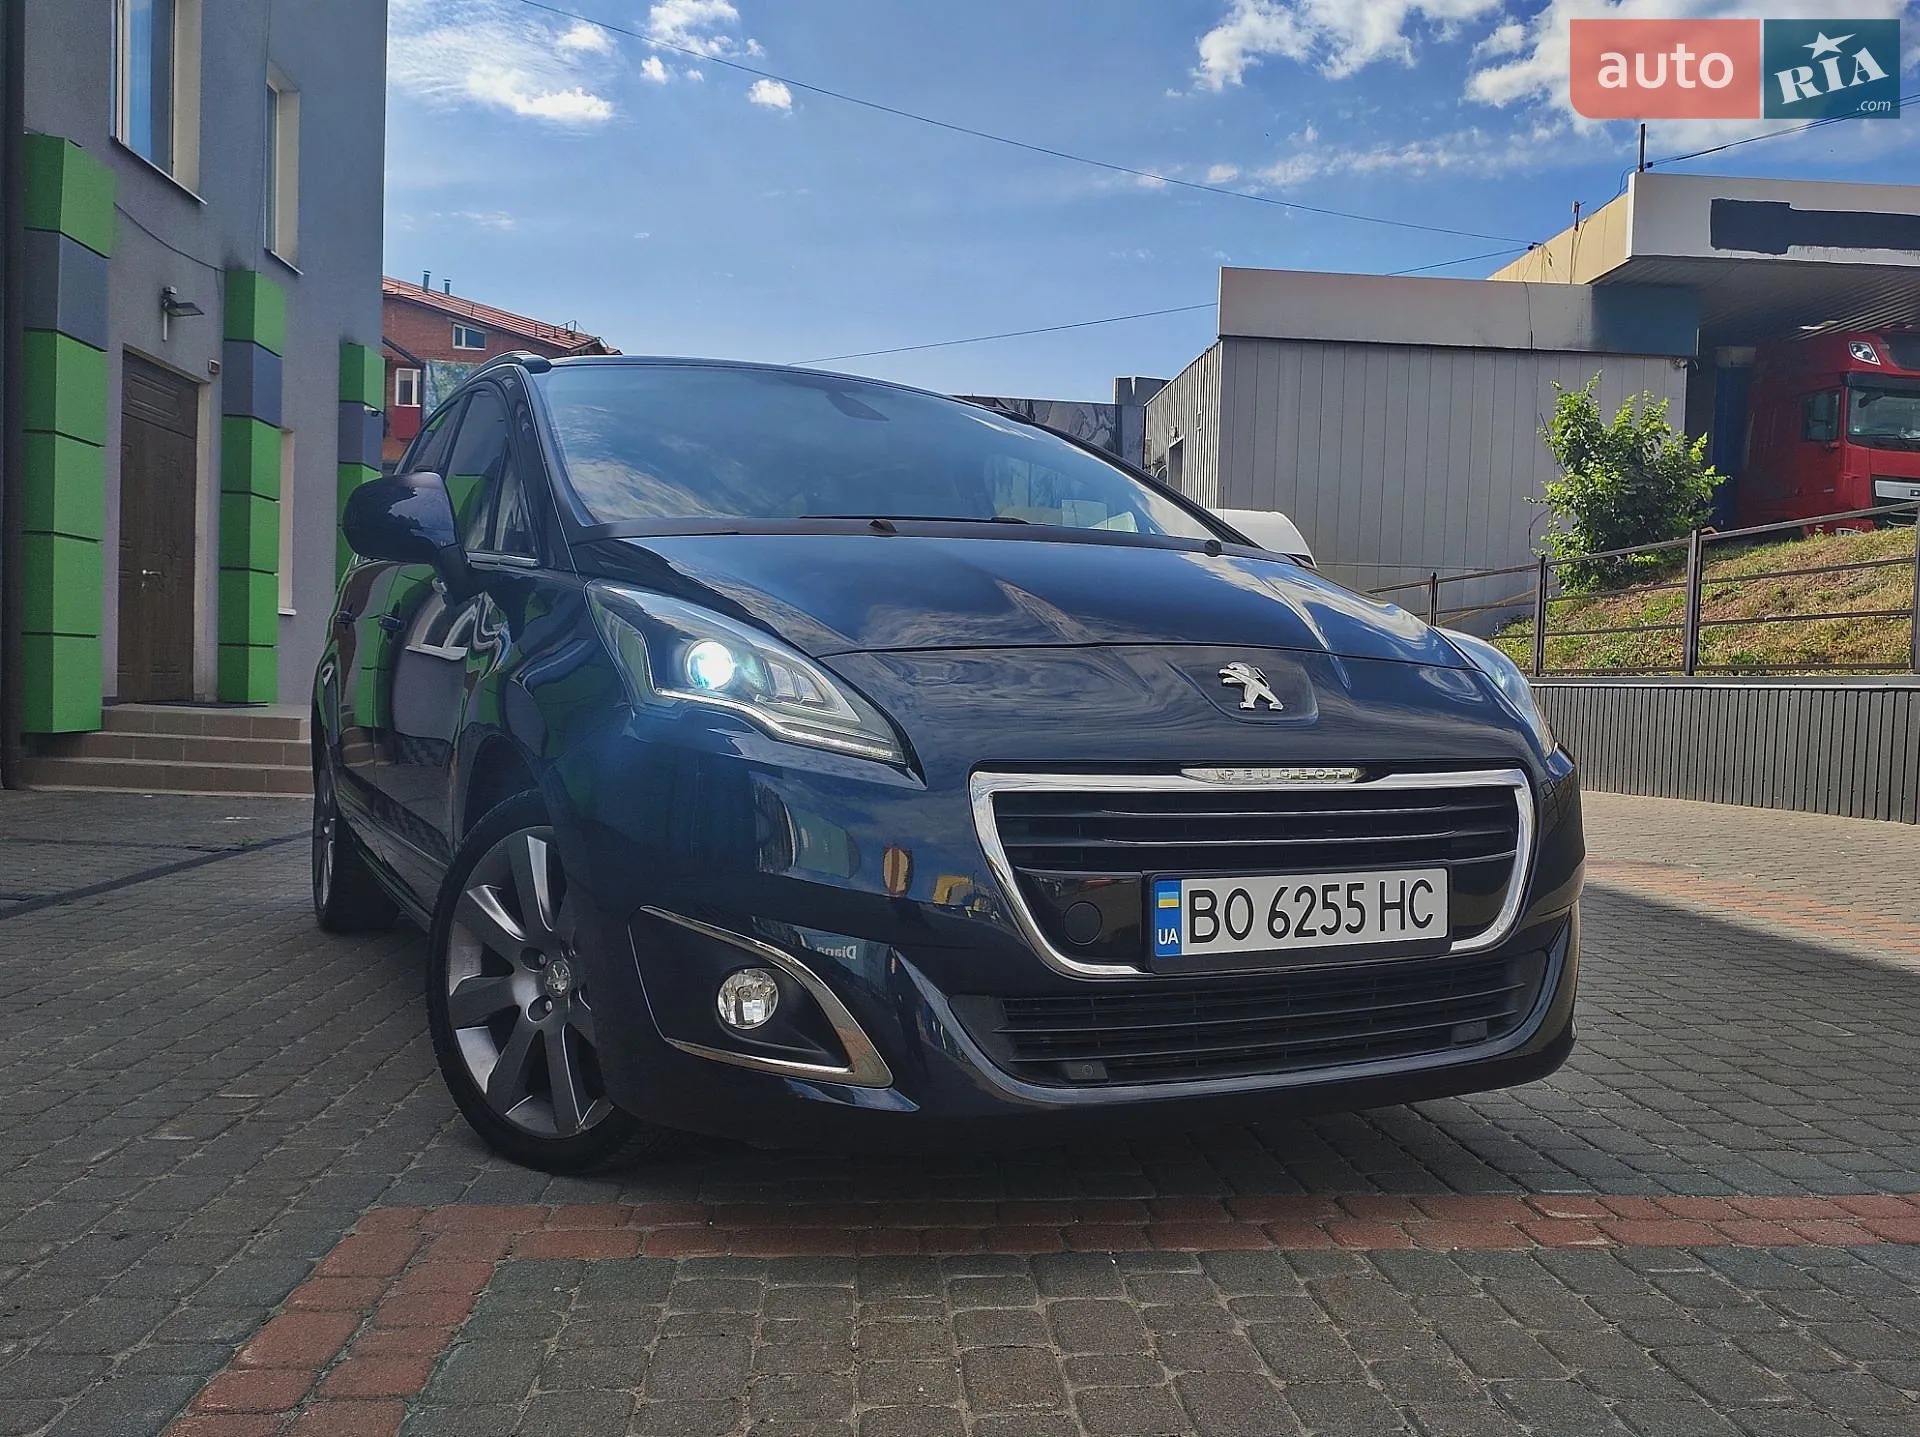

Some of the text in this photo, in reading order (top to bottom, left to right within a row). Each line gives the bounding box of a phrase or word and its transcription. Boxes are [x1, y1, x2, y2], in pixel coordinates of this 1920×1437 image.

[1224, 769, 1342, 781] PEUGEOT
[1189, 879, 1434, 944] BO 6255 HC
[1158, 928, 1179, 945] UA
